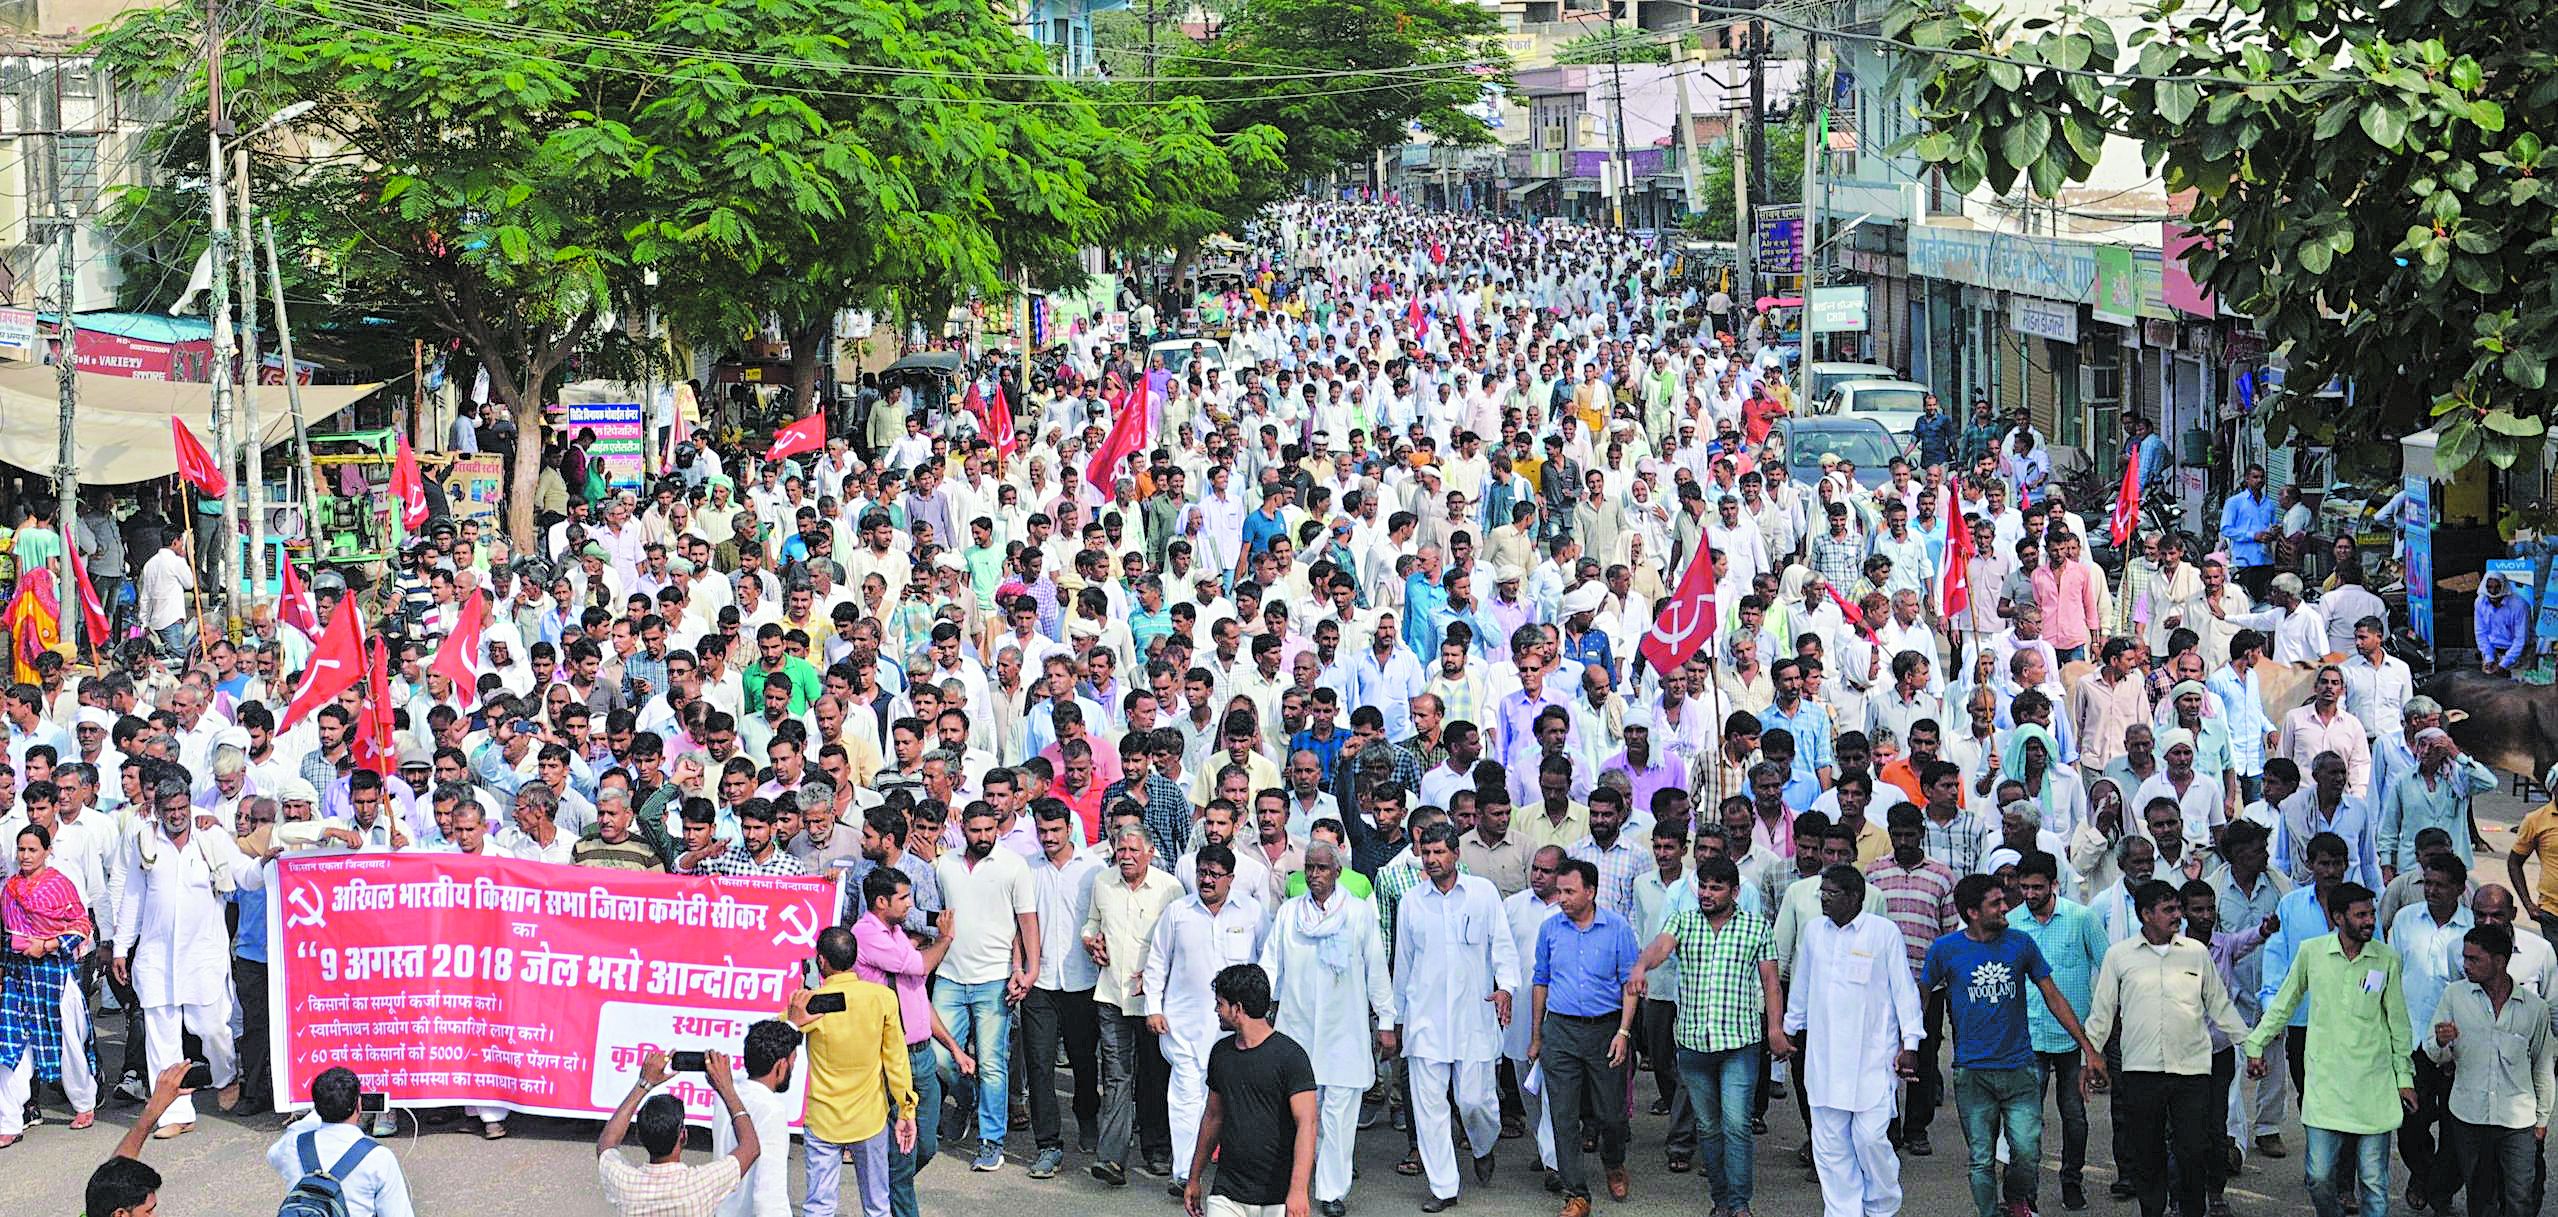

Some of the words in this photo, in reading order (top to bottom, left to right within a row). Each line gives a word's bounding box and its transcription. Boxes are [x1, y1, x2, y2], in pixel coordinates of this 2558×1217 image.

[100, 354, 143, 368] VARIETY
[288, 862, 316, 872] किसान
[318, 862, 344, 872] एकता
[718, 878, 750, 888] किसान
[752, 880, 772, 889] सभा
[332, 878, 396, 912] अखिल
[399, 875, 472, 910] भारतीय
[475, 876, 544, 914] किसान
[545, 889, 588, 918] सभा
[590, 886, 648, 922] जिला
[649, 892, 709, 927] कमेटी
[711, 895, 768, 932] सीकर
[512, 922, 538, 938] का
[345, 945, 427, 980] अगस्त
[432, 944, 514, 982] 2018
[520, 942, 584, 986] जेल
[588, 948, 644, 992] भरो
[308, 994, 350, 1012] किसानों
[352, 997, 369, 1010] का
[371, 991, 406, 1014] सम्पूर्ण
[409, 990, 441, 1009] कर्जा
[442, 994, 473, 1009] माफ
[1968, 981, 2016, 1004] WOODLAND
[309, 1018, 370, 1038] स्वामीनाथन
[373, 1017, 408, 1036] आयोग
[412, 1016, 430, 1034] की
[490, 1024, 516, 1044] लागू
[311, 1049, 328, 1063] 60
[330, 1044, 348, 1062] वर्ष
[351, 1044, 362, 1062] के
[365, 1043, 406, 1062] किसानों
[408, 1042, 426, 1060] को
[482, 1045, 524, 1068] प्रतिमाह
[392, 1068, 408, 1086] की
[410, 1072, 450, 1086] समस्या
[452, 1072, 471, 1086] का
[474, 1072, 518, 1091] समाधान
